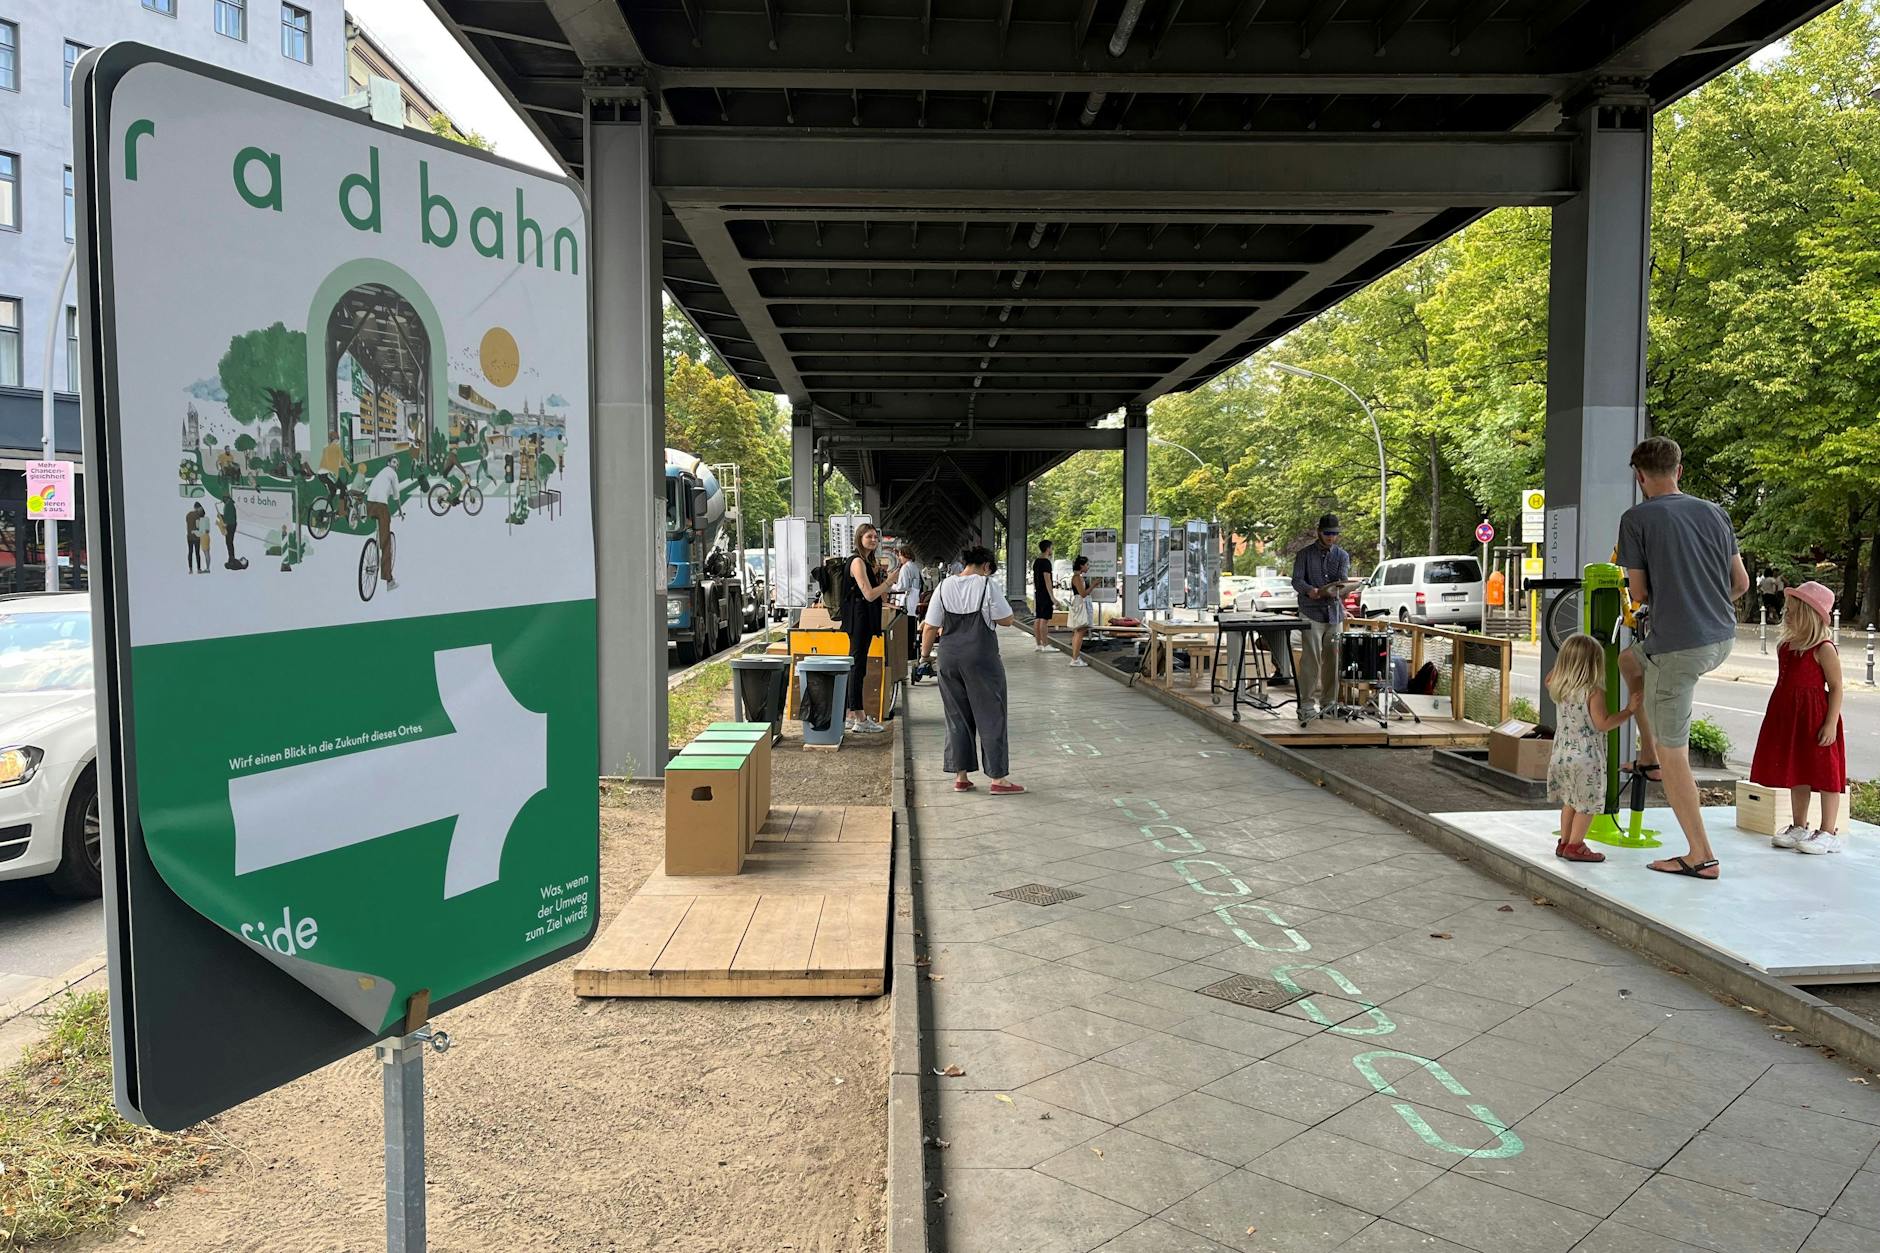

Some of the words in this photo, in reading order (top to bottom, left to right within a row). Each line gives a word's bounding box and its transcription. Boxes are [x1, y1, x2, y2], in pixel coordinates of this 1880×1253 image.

[229, 756, 252, 770] Wirf
[255, 752, 282, 765] einen
[284, 747, 306, 759] Blick
[308, 744, 317, 754] in
[319, 741, 333, 752] die
[335, 734, 369, 749] Zukunft
[370, 729, 397, 742] dieses
[397, 724, 422, 737] Ortes
[540, 884, 563, 899] Was,
[566, 875, 589, 890] wenn
[537, 905, 553, 919] der
[555, 892, 588, 911] Umweg
[525, 927, 544, 942] zum
[546, 914, 563, 933] Ziel
[565, 905, 588, 924] wird?
